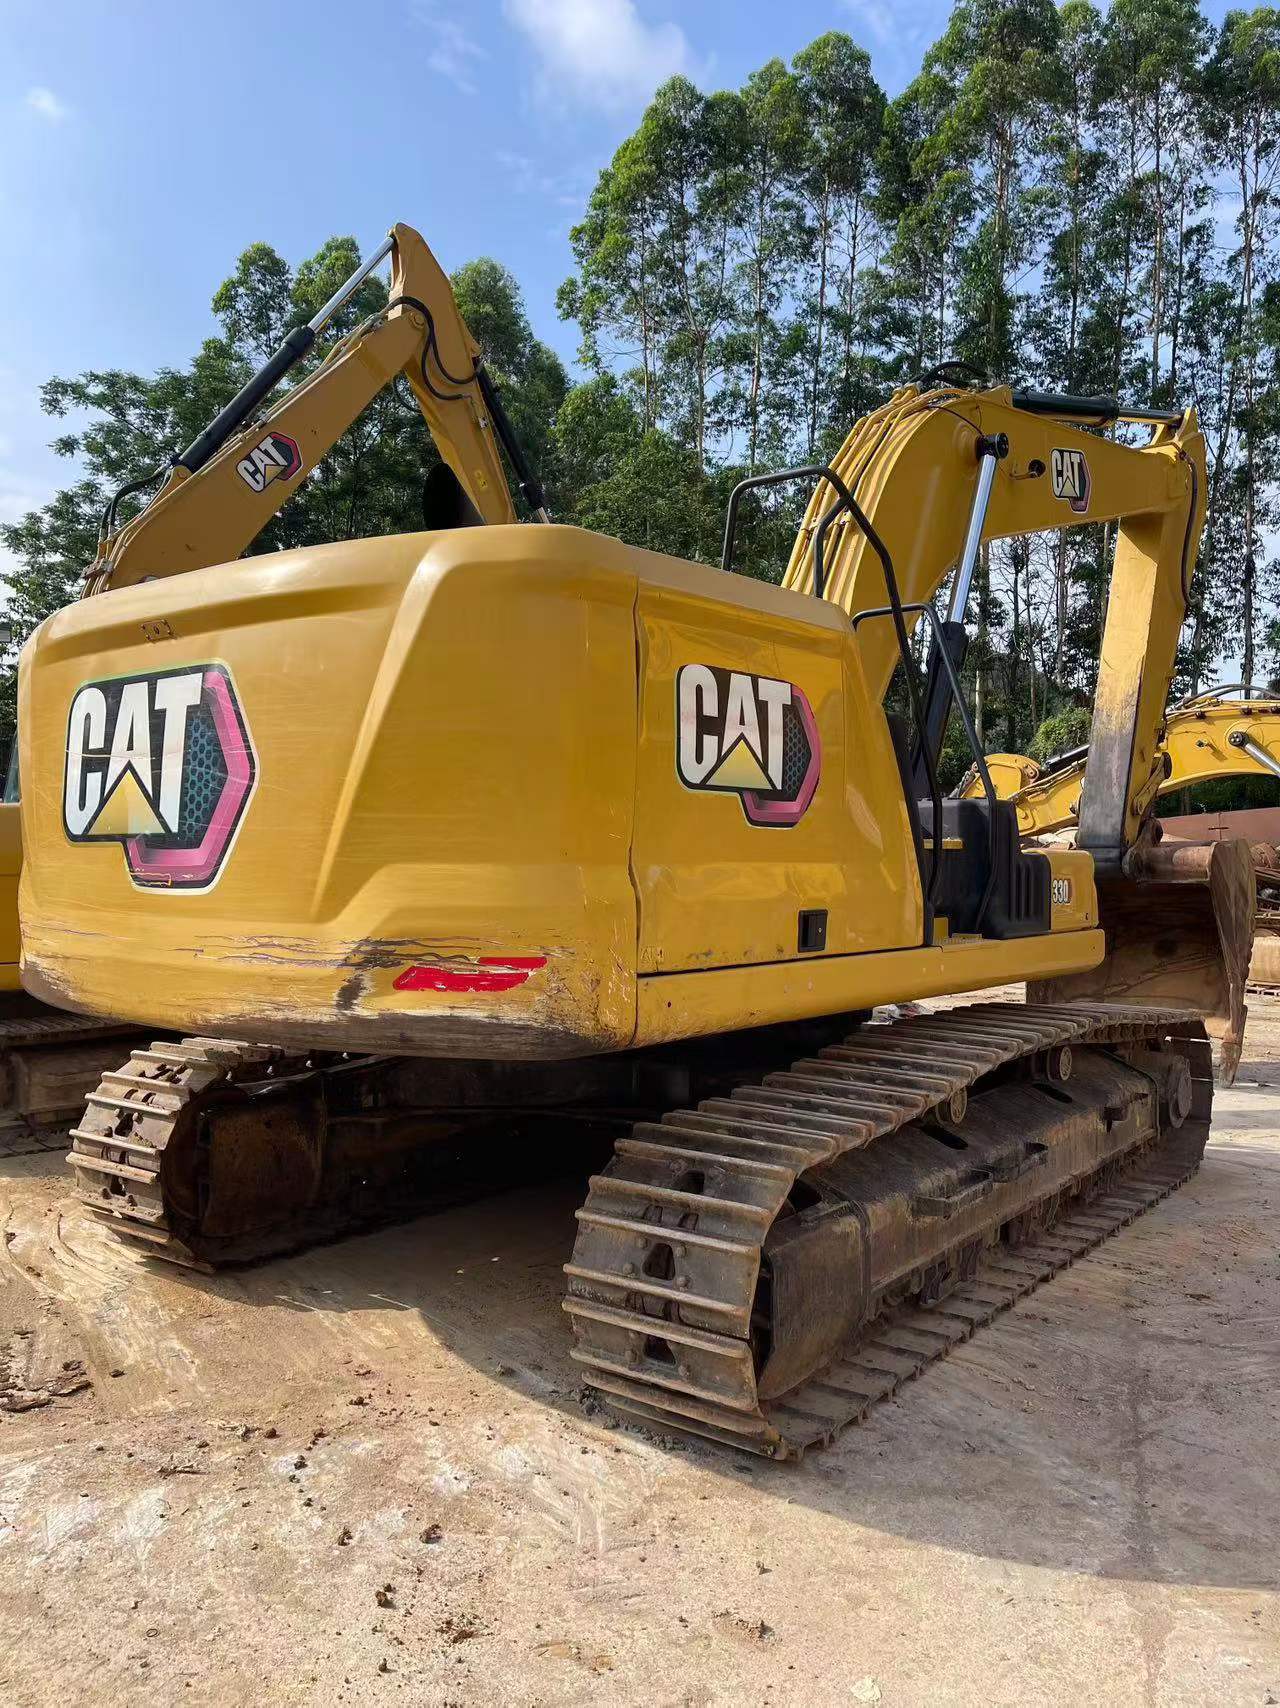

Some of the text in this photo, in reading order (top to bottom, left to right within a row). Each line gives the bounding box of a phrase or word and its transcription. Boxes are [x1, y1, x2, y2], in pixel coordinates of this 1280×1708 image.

[236, 436, 288, 492] CAT
[1052, 449, 1080, 497] CAT
[65, 672, 203, 835] CAT
[679, 663, 791, 790] CAT
[1053, 879, 1069, 903] 330
